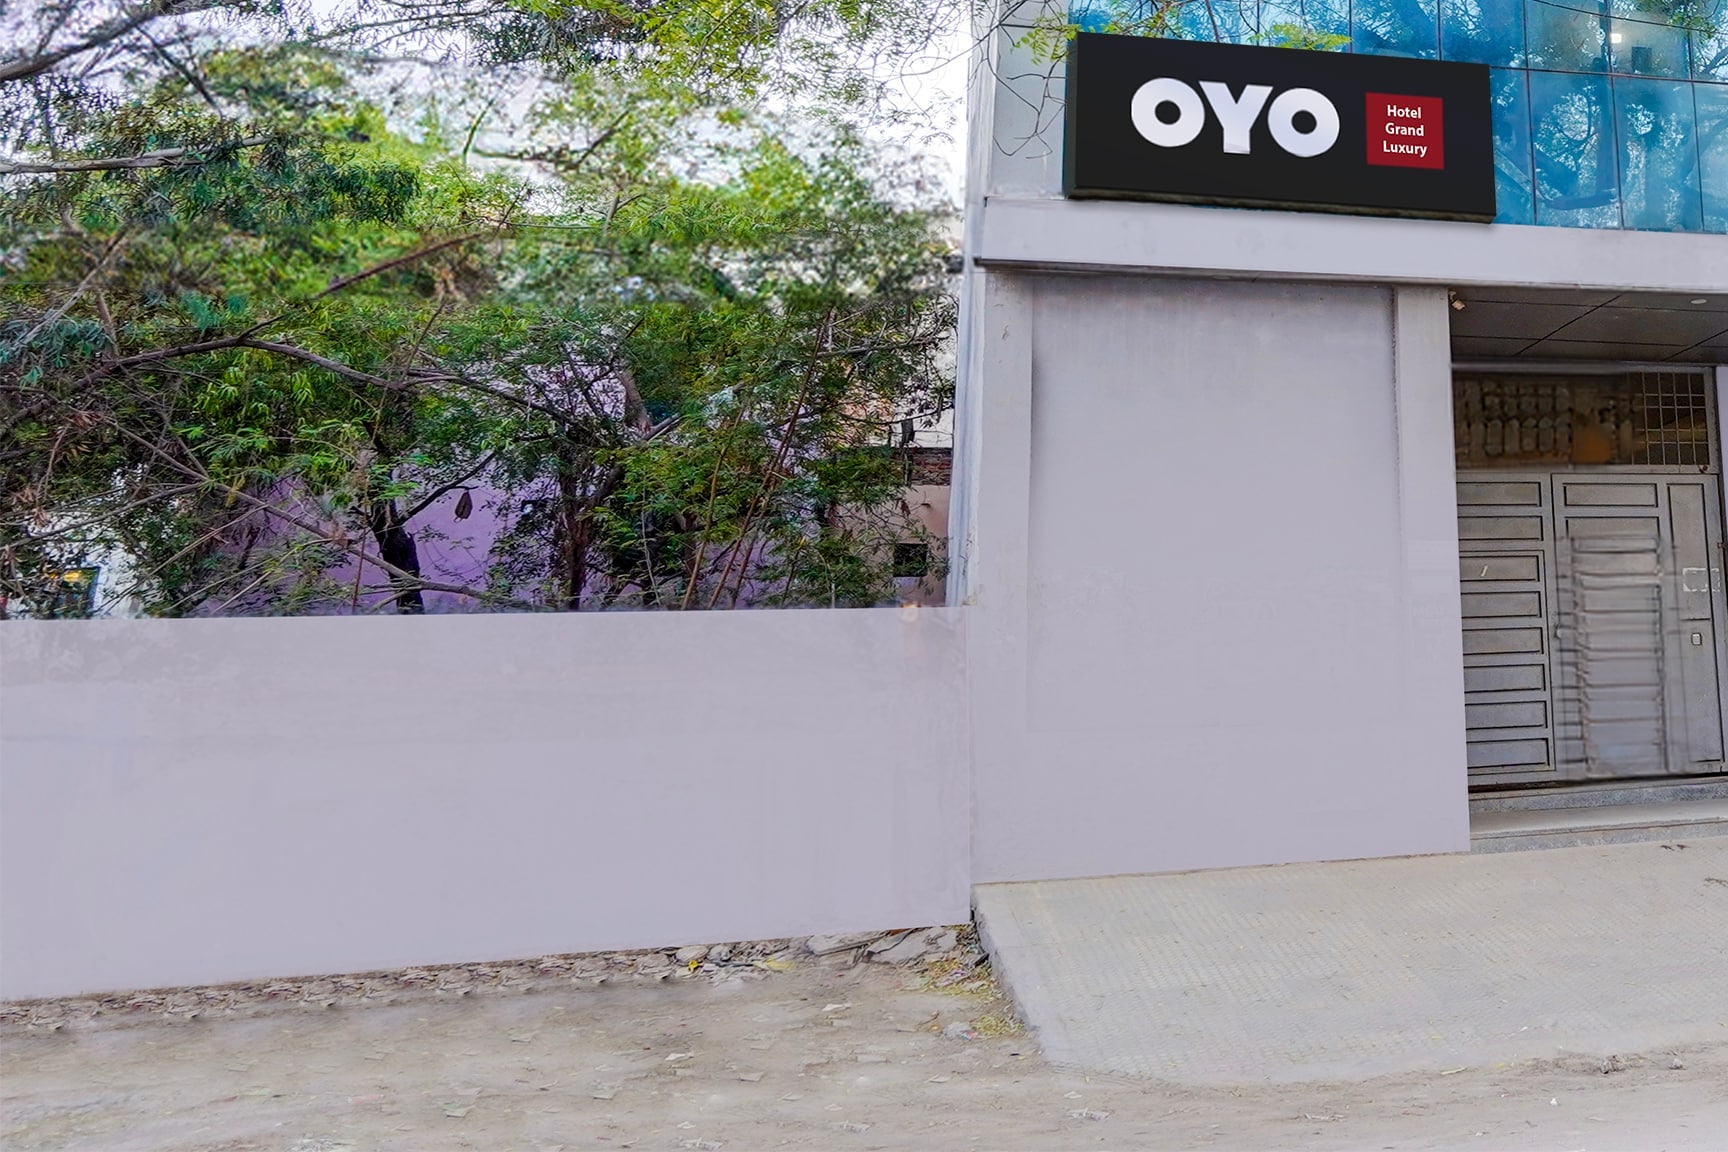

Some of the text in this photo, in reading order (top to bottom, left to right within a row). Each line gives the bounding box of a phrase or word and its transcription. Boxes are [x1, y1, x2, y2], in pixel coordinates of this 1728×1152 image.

[1131, 77, 1340, 158] OYO
[1387, 104, 1421, 119] Hotel
[1385, 122, 1424, 136] Grand
[1383, 139, 1427, 158] Luxury
